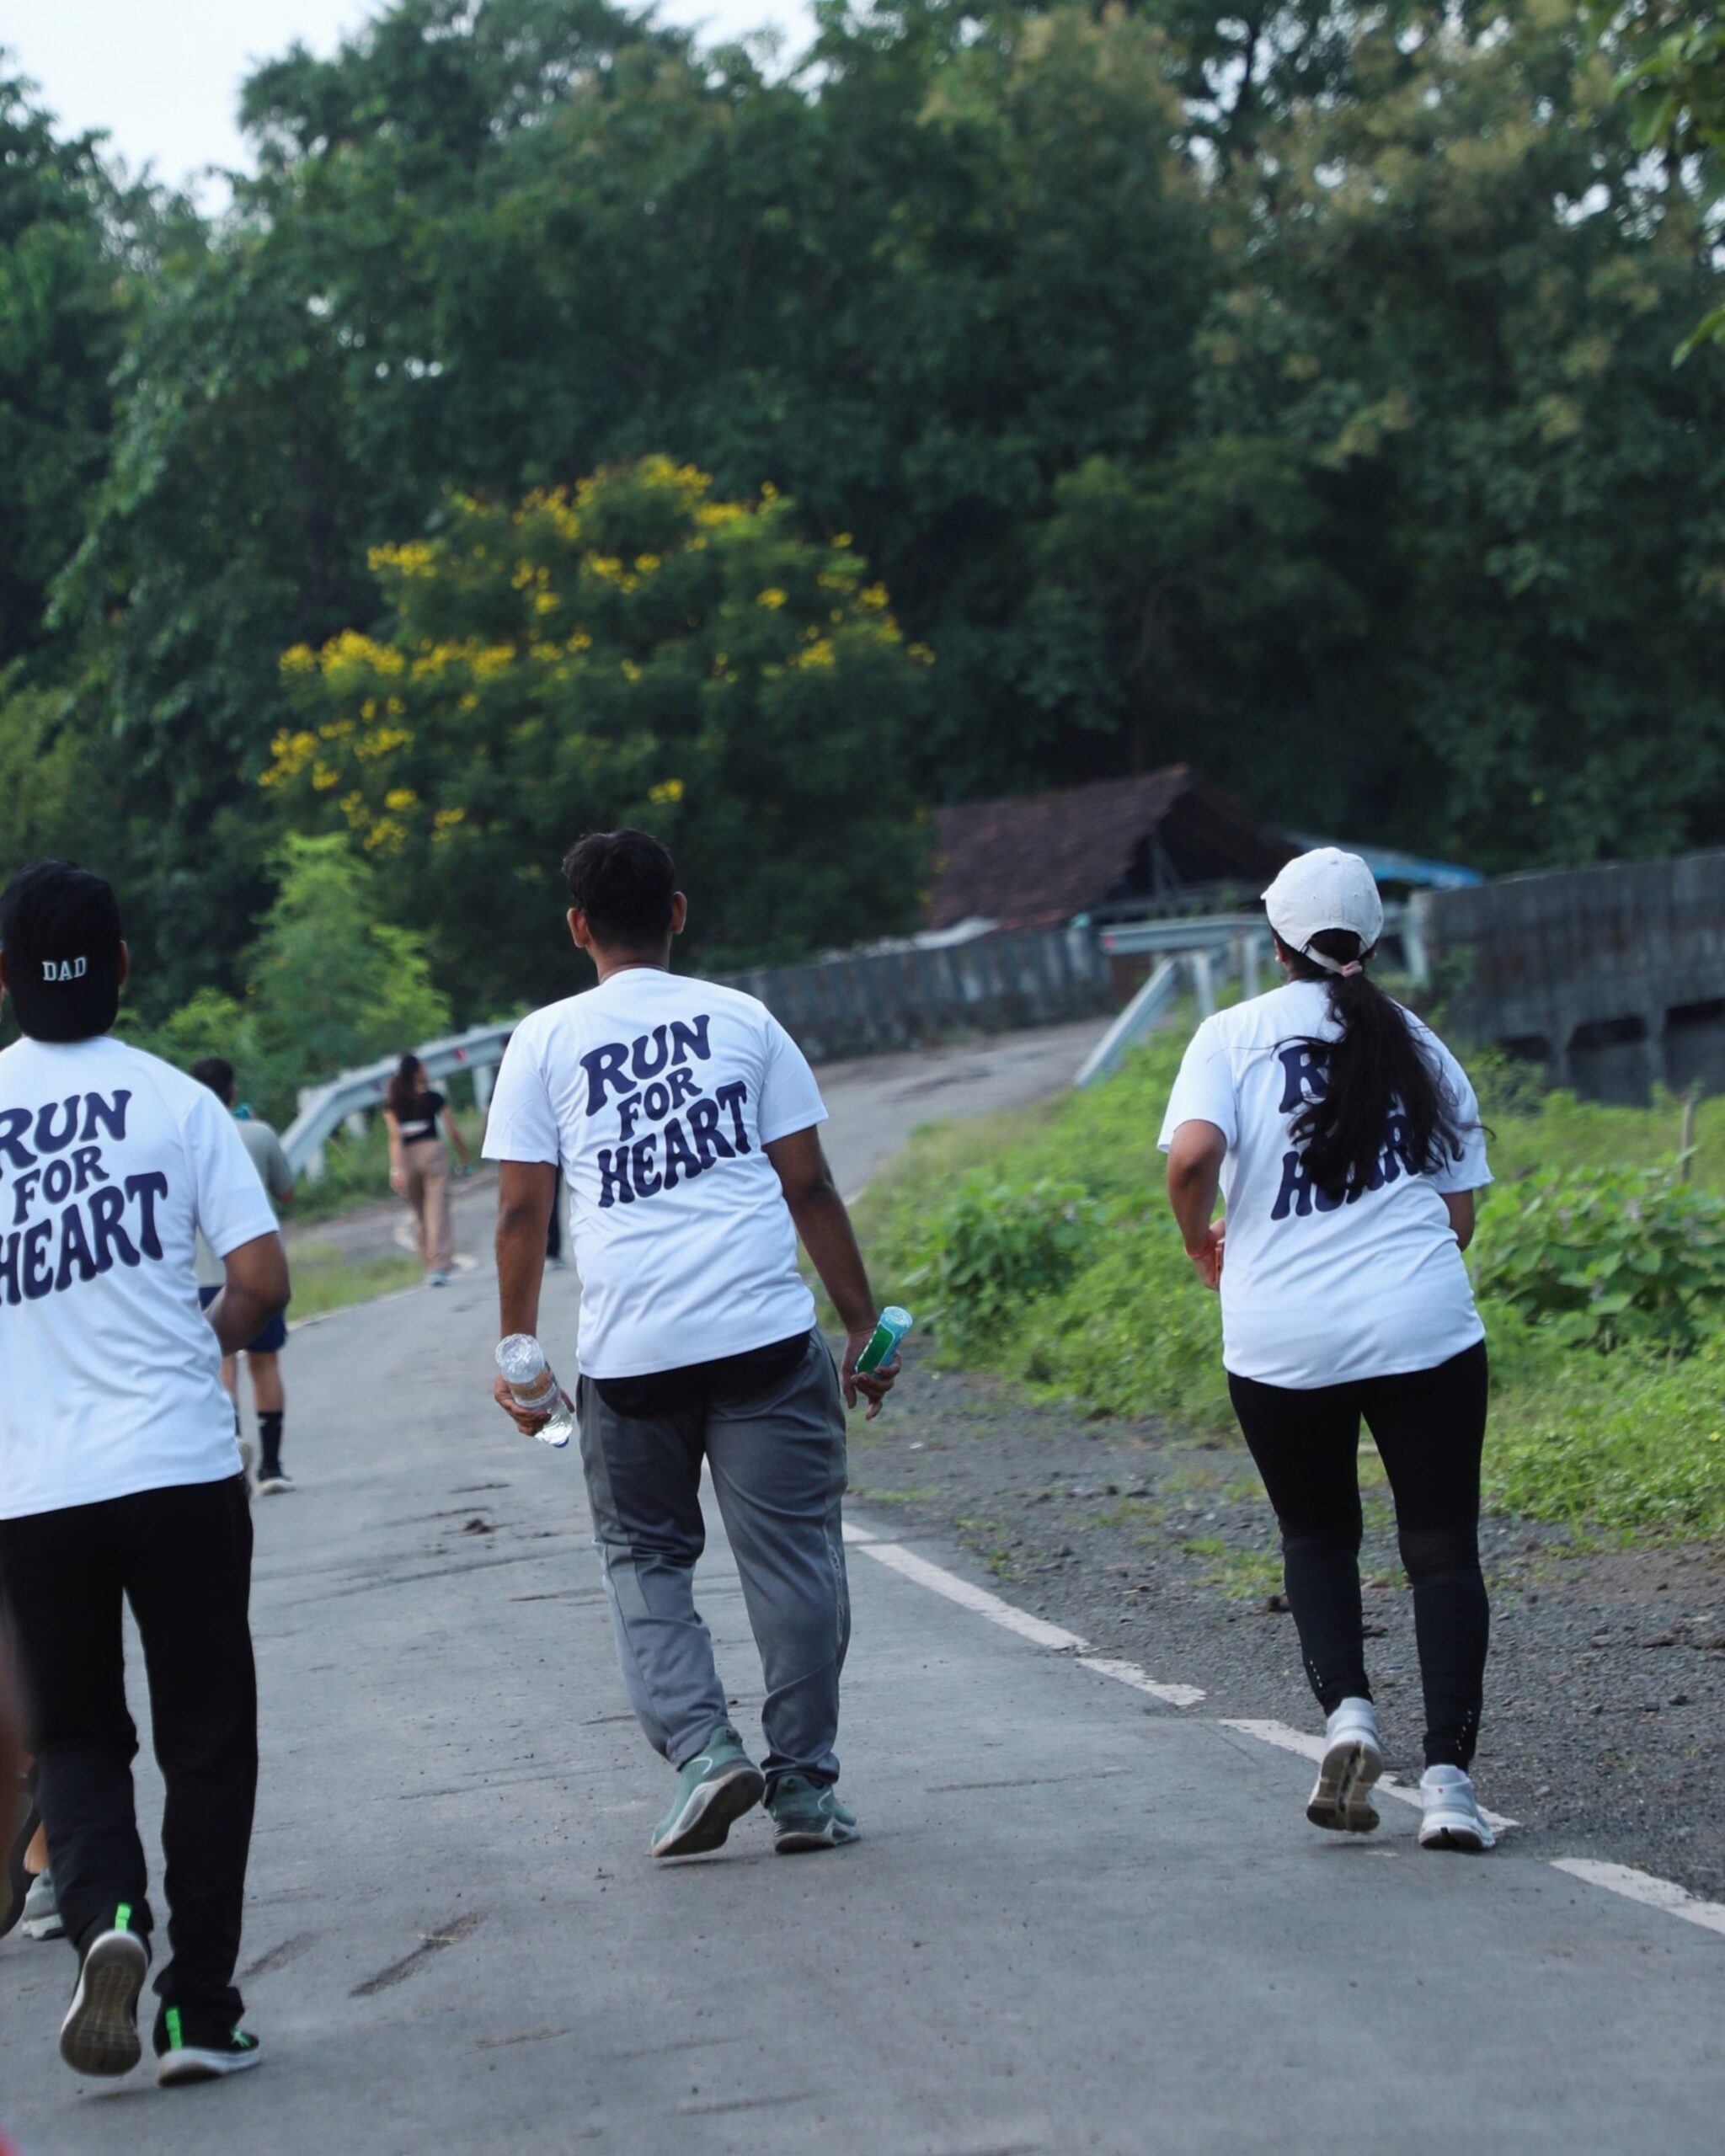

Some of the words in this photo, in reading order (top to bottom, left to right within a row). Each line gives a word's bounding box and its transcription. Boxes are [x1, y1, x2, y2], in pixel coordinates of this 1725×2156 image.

[41, 956, 86, 981] DAD
[579, 1014, 712, 1117] RUN
[617, 1067, 702, 1142] FOR
[597, 1081, 751, 1208] HEART
[12, 1145, 110, 1226] FOR
